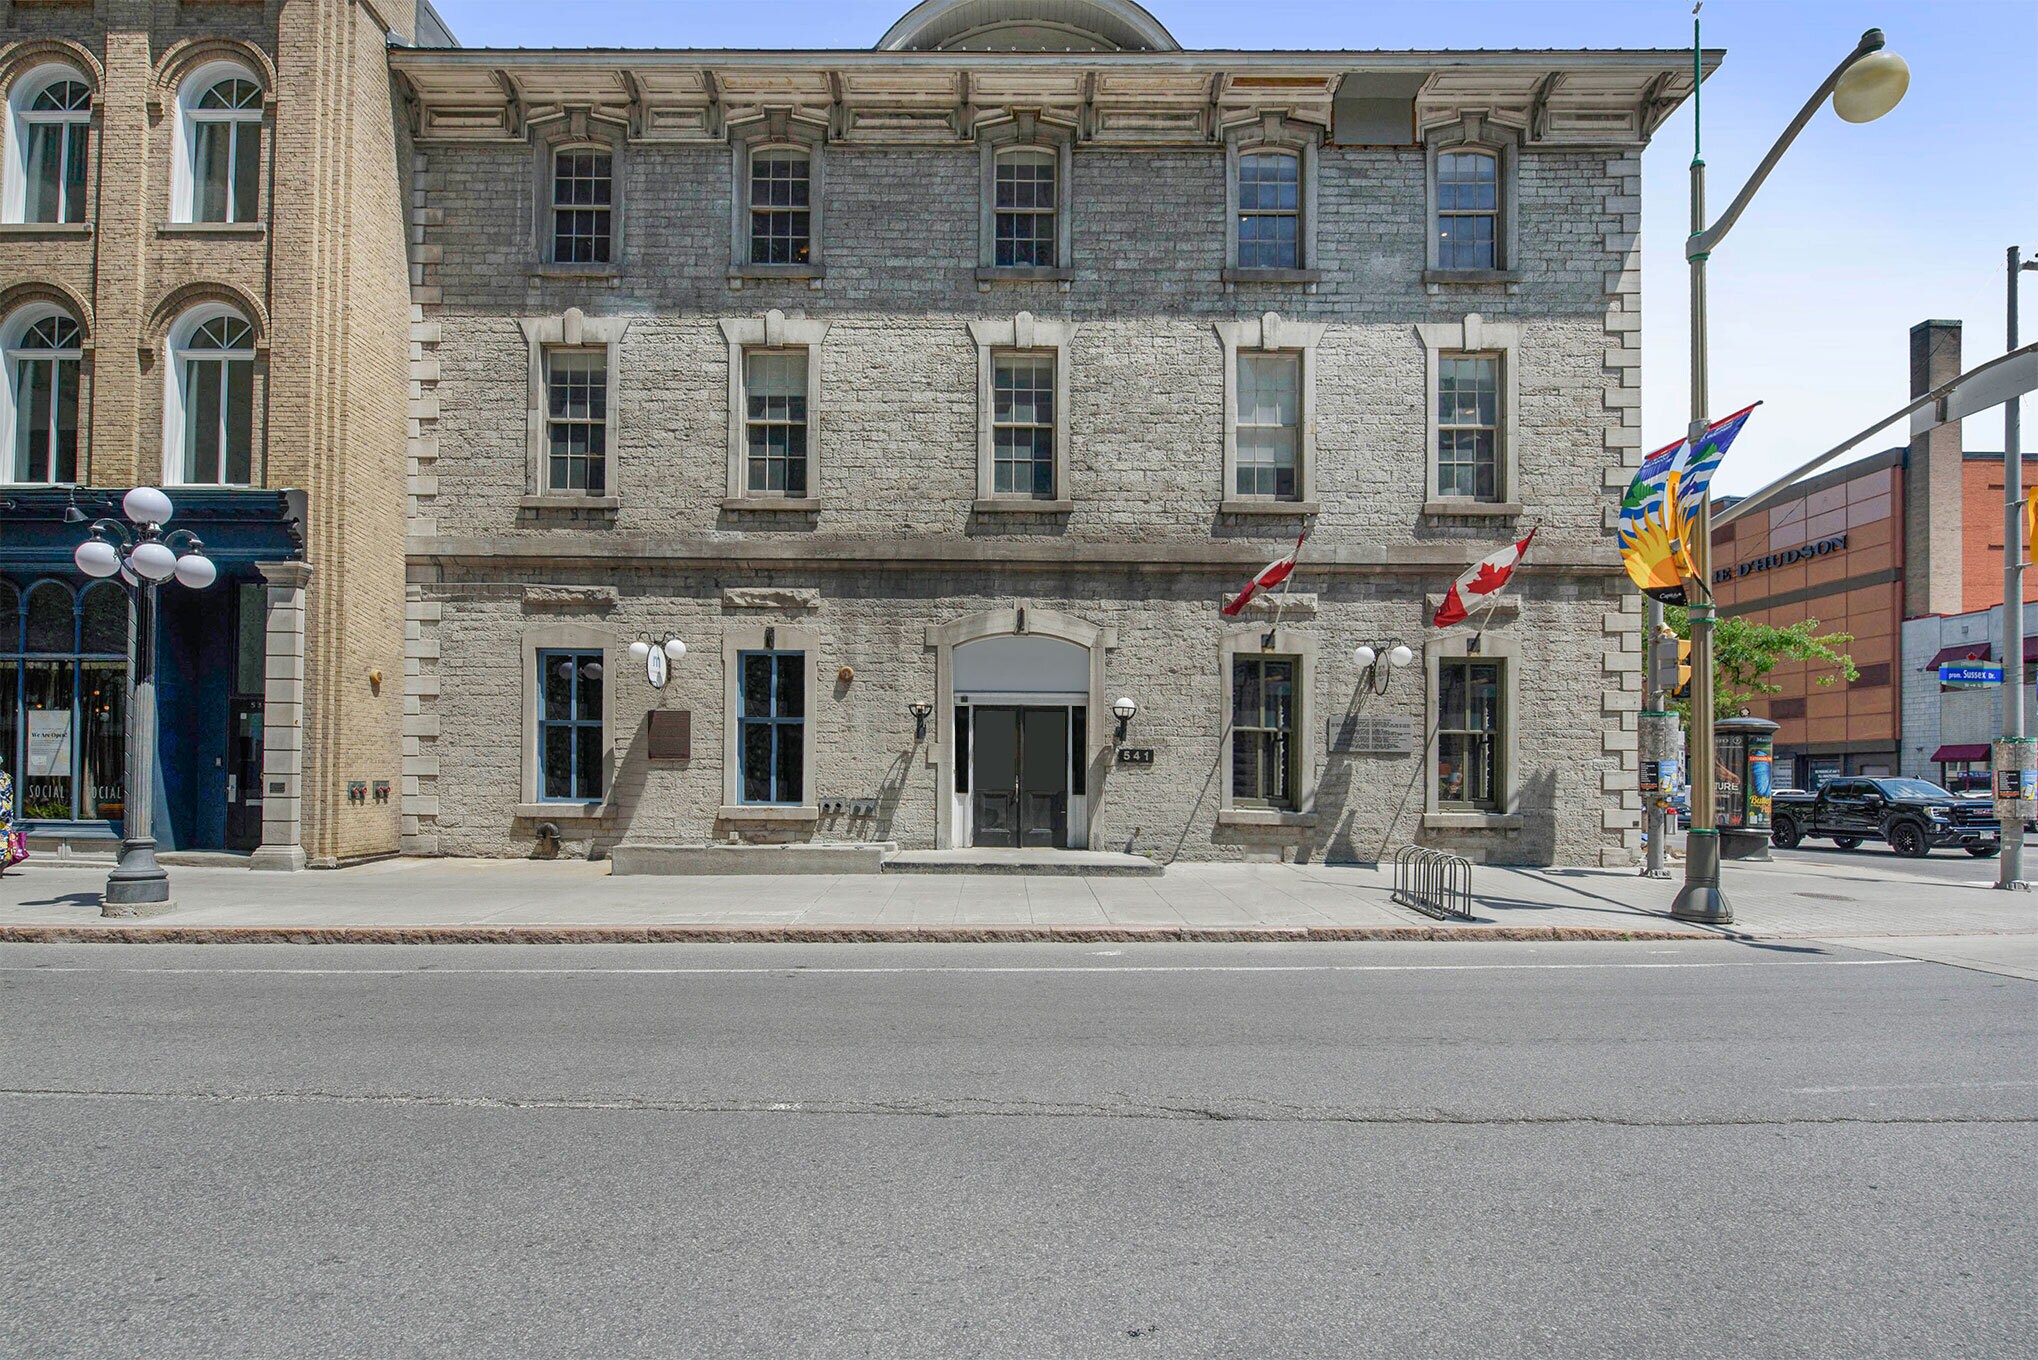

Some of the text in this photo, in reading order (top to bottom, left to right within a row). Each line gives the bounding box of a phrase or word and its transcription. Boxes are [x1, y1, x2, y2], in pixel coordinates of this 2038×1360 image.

[1712, 534, 1848, 583] IE D'HUDSON
[1963, 669, 1987, 679] Sussex
[1123, 750, 1149, 761] 541
[29, 784, 65, 799] SOCIAL
[88, 785, 122, 800] OCIAL
[1714, 782, 1739, 791] TURE
